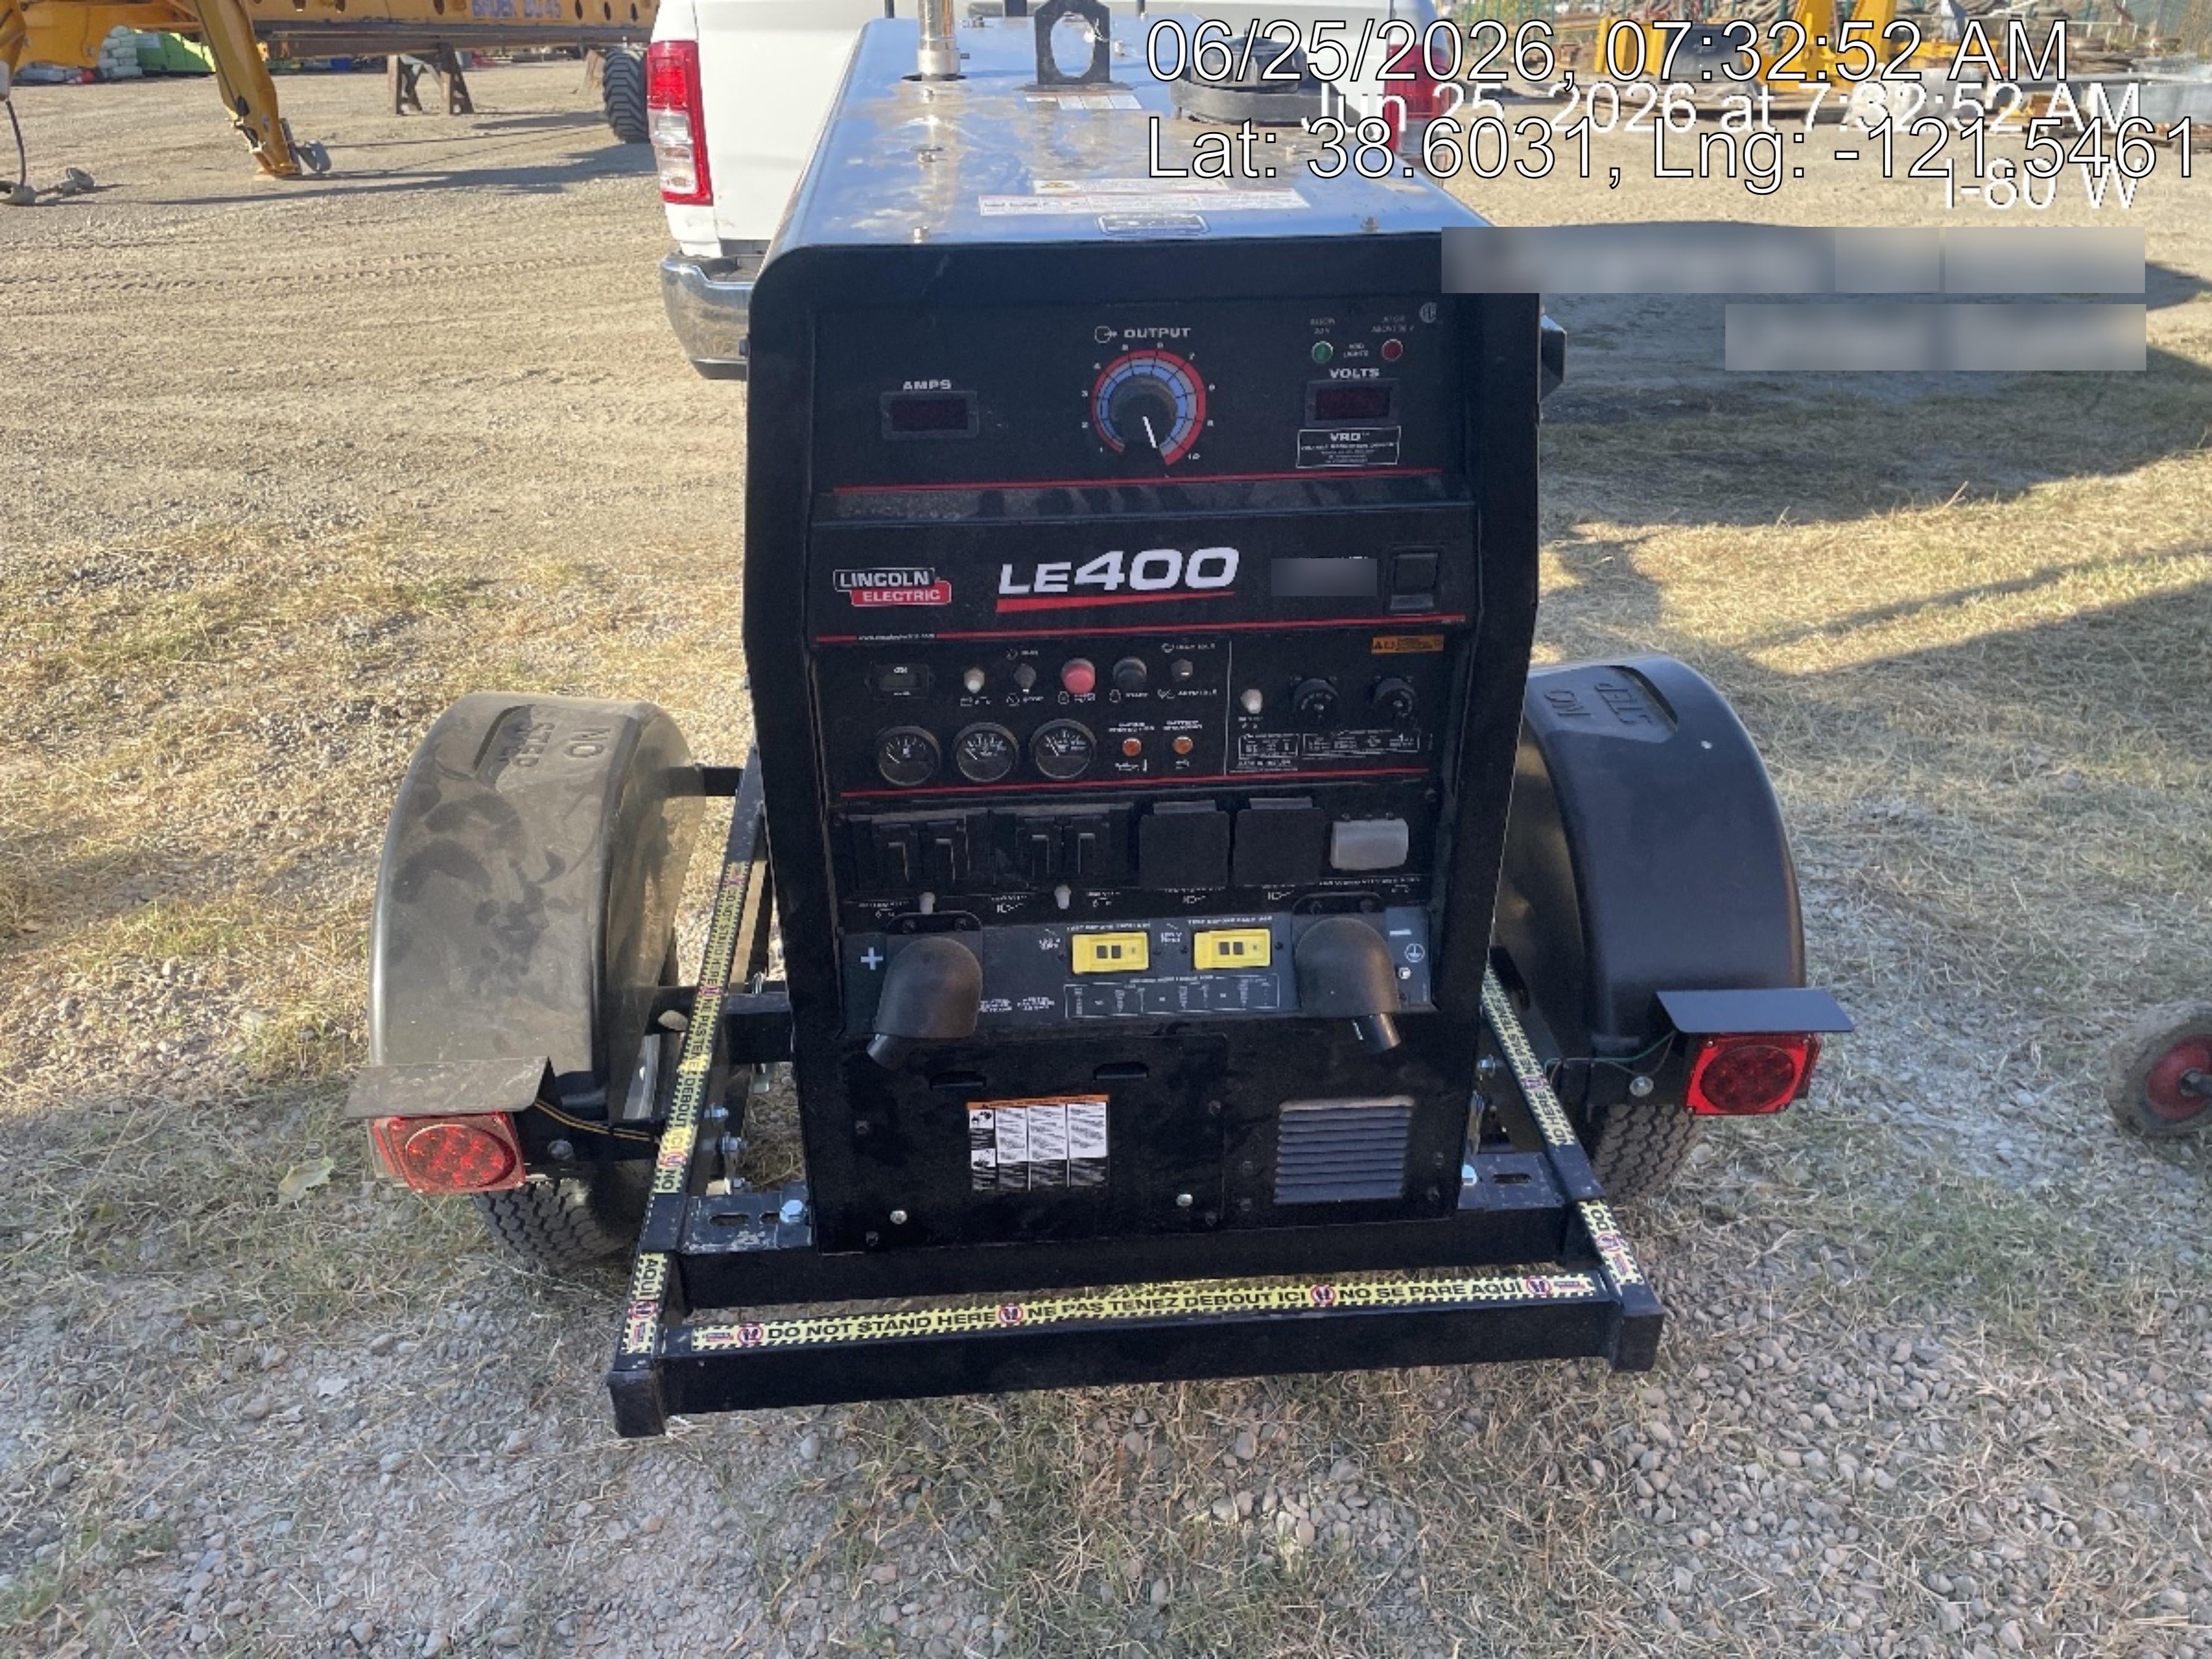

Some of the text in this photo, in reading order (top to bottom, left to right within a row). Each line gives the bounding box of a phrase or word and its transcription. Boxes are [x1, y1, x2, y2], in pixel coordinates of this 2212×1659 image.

[1124, 327, 1191, 338] OUTPUT
[1329, 369, 1379, 378] VOLTS
[903, 379, 952, 390] AMPS
[998, 547, 1239, 594] LE400
[840, 571, 929, 587] LINCOLN
[862, 589, 941, 602] ELECTRIC
[674, 1078, 696, 1129] DEBOUT
[1339, 1288, 1371, 1299] NO
[1376, 1286, 1405, 1296] SE
[1408, 1284, 1466, 1296] PARE
[1027, 1292, 1306, 1319] NE PAS TENEZ DEBOUT ICI
[768, 1312, 995, 1339] DO NOT STAND HERE
